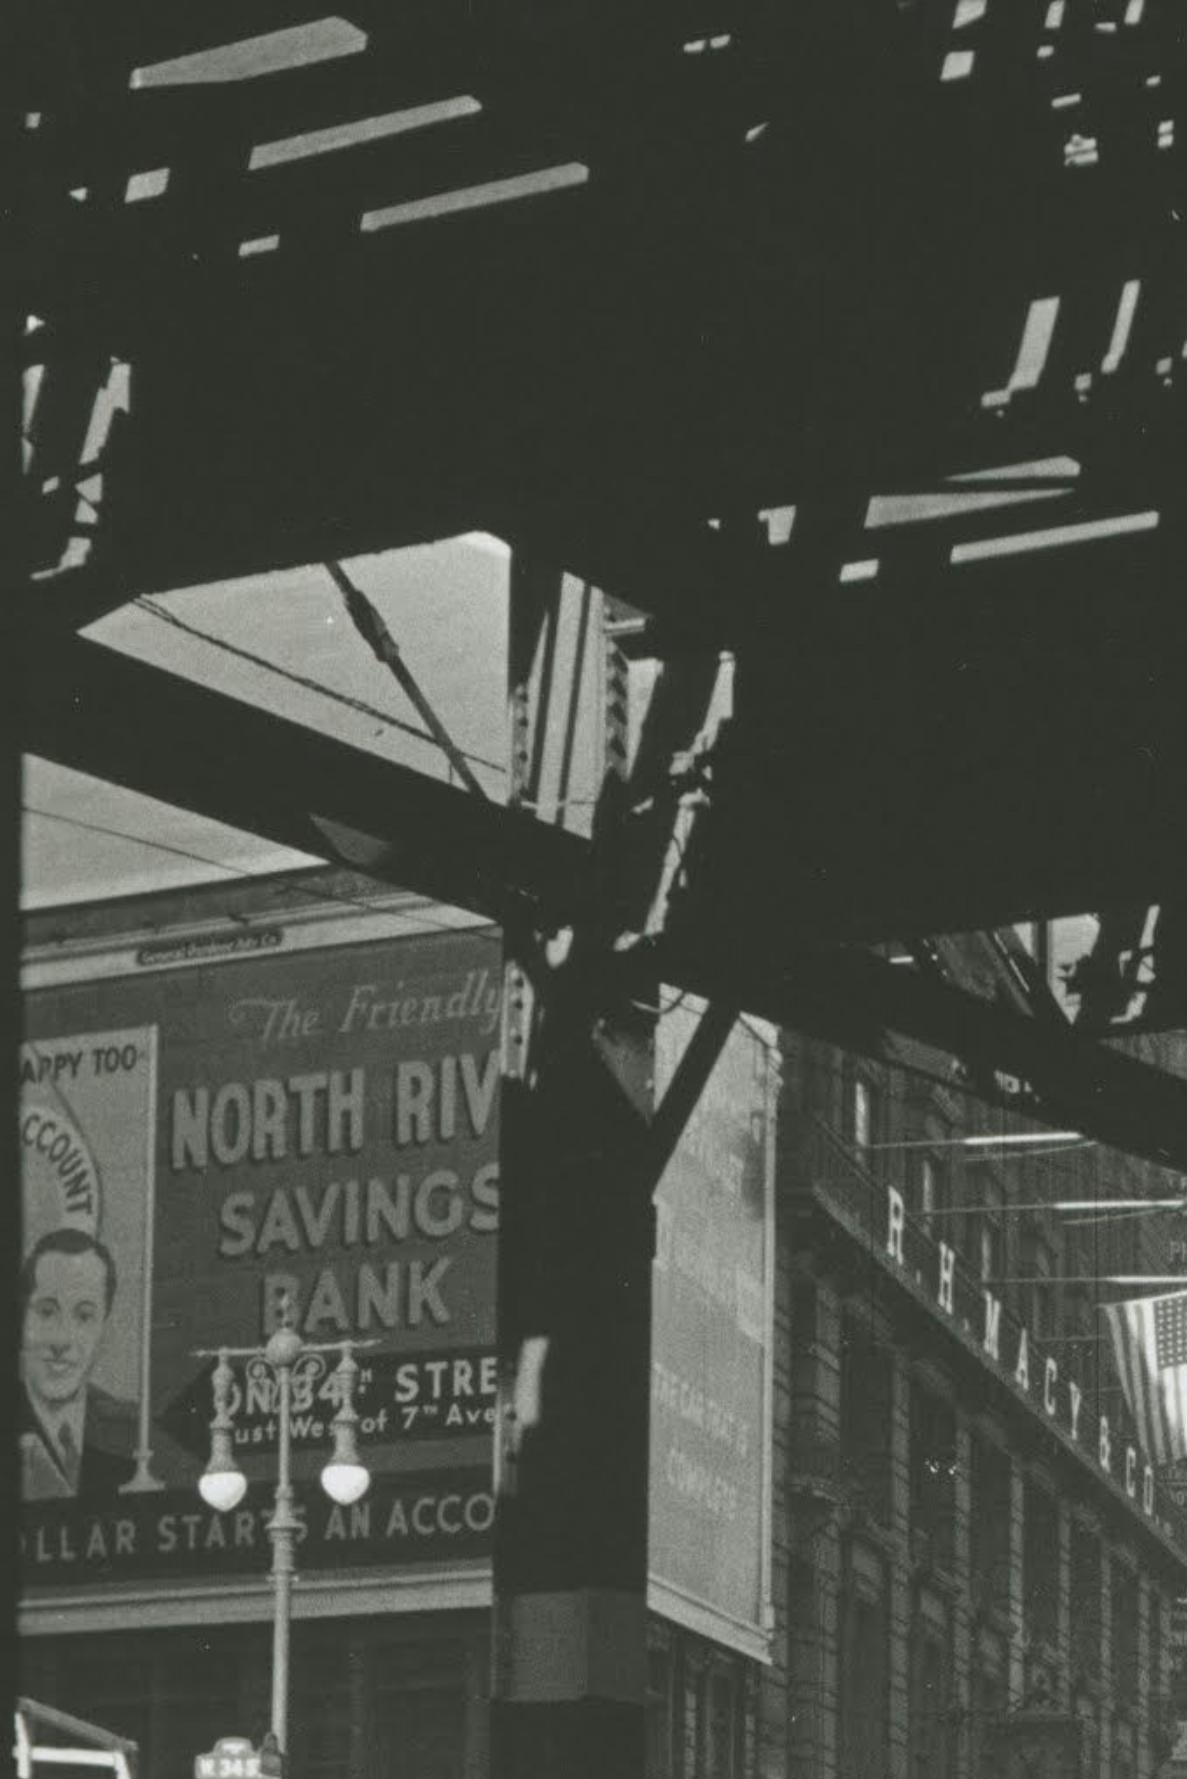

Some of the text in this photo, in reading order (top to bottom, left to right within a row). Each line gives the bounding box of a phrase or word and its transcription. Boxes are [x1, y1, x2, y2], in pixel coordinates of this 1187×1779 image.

[229, 969, 501, 1050] The Friendly
[21, 1044, 138, 1085] APPY TOO
[171, 1067, 366, 1171] NORTH
[22, 1114, 93, 1215] CCOUNT
[219, 1161, 501, 1257] SAVINGS
[260, 1257, 454, 1334] BANK
[394, 1356, 497, 1402] STRE
[981, 1290, 1083, 1442] MACY
[233, 1418, 277, 1444] ust
[361, 1408, 388, 1433] of
[21, 1518, 137, 1562] LLAR
[325, 1502, 371, 1541] AN
[386, 1492, 496, 1538] ACCO
[219, 1758, 243, 1778] 34
